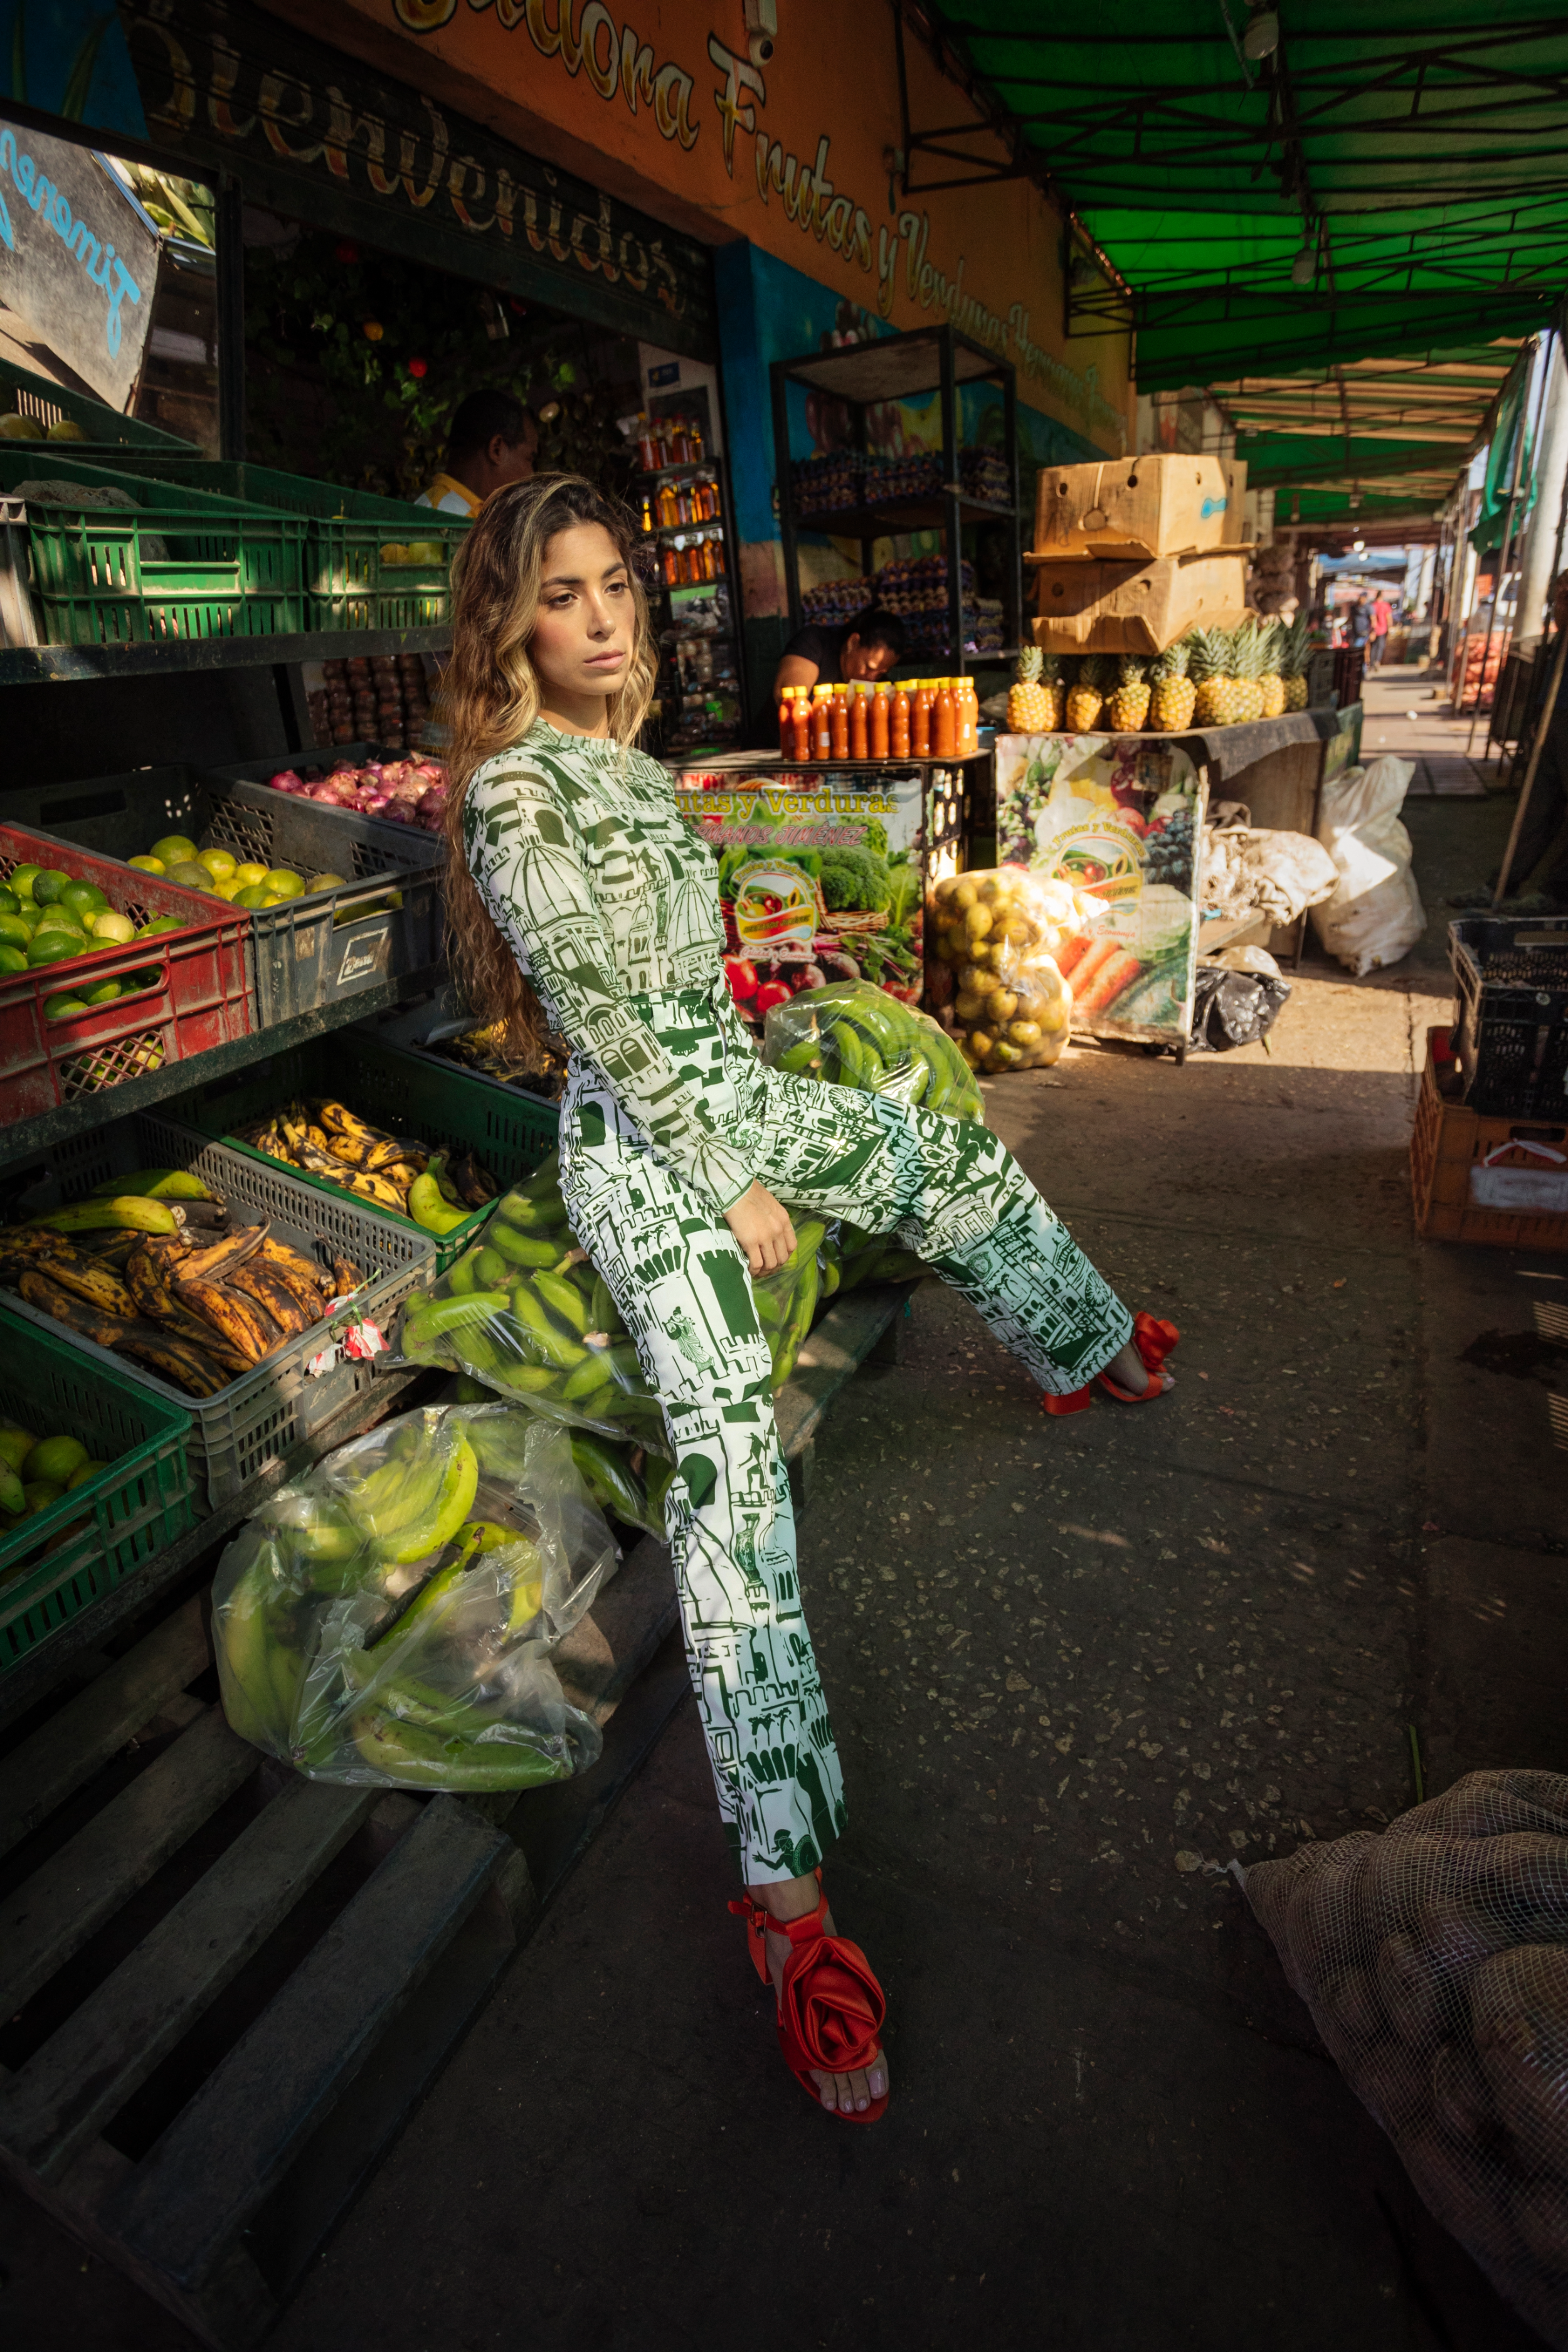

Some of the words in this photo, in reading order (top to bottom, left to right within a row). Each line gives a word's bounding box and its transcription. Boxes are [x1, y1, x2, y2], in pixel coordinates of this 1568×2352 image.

[707, 31, 872, 272] Frutas
[878, 224, 898, 319] y
[674, 788, 732, 813] utas
[738, 793, 757, 820] y
[763, 788, 901, 813] Verduras
[692, 825, 773, 844] RMANOS
[775, 821, 868, 846] JIMÉNEZ
[1052, 823, 1090, 846] Frutas
[1092, 823, 1100, 834] y
[1103, 821, 1147, 857] Verduras
[734, 861, 765, 882] Frutas
[774, 860, 815, 890] Verduras
